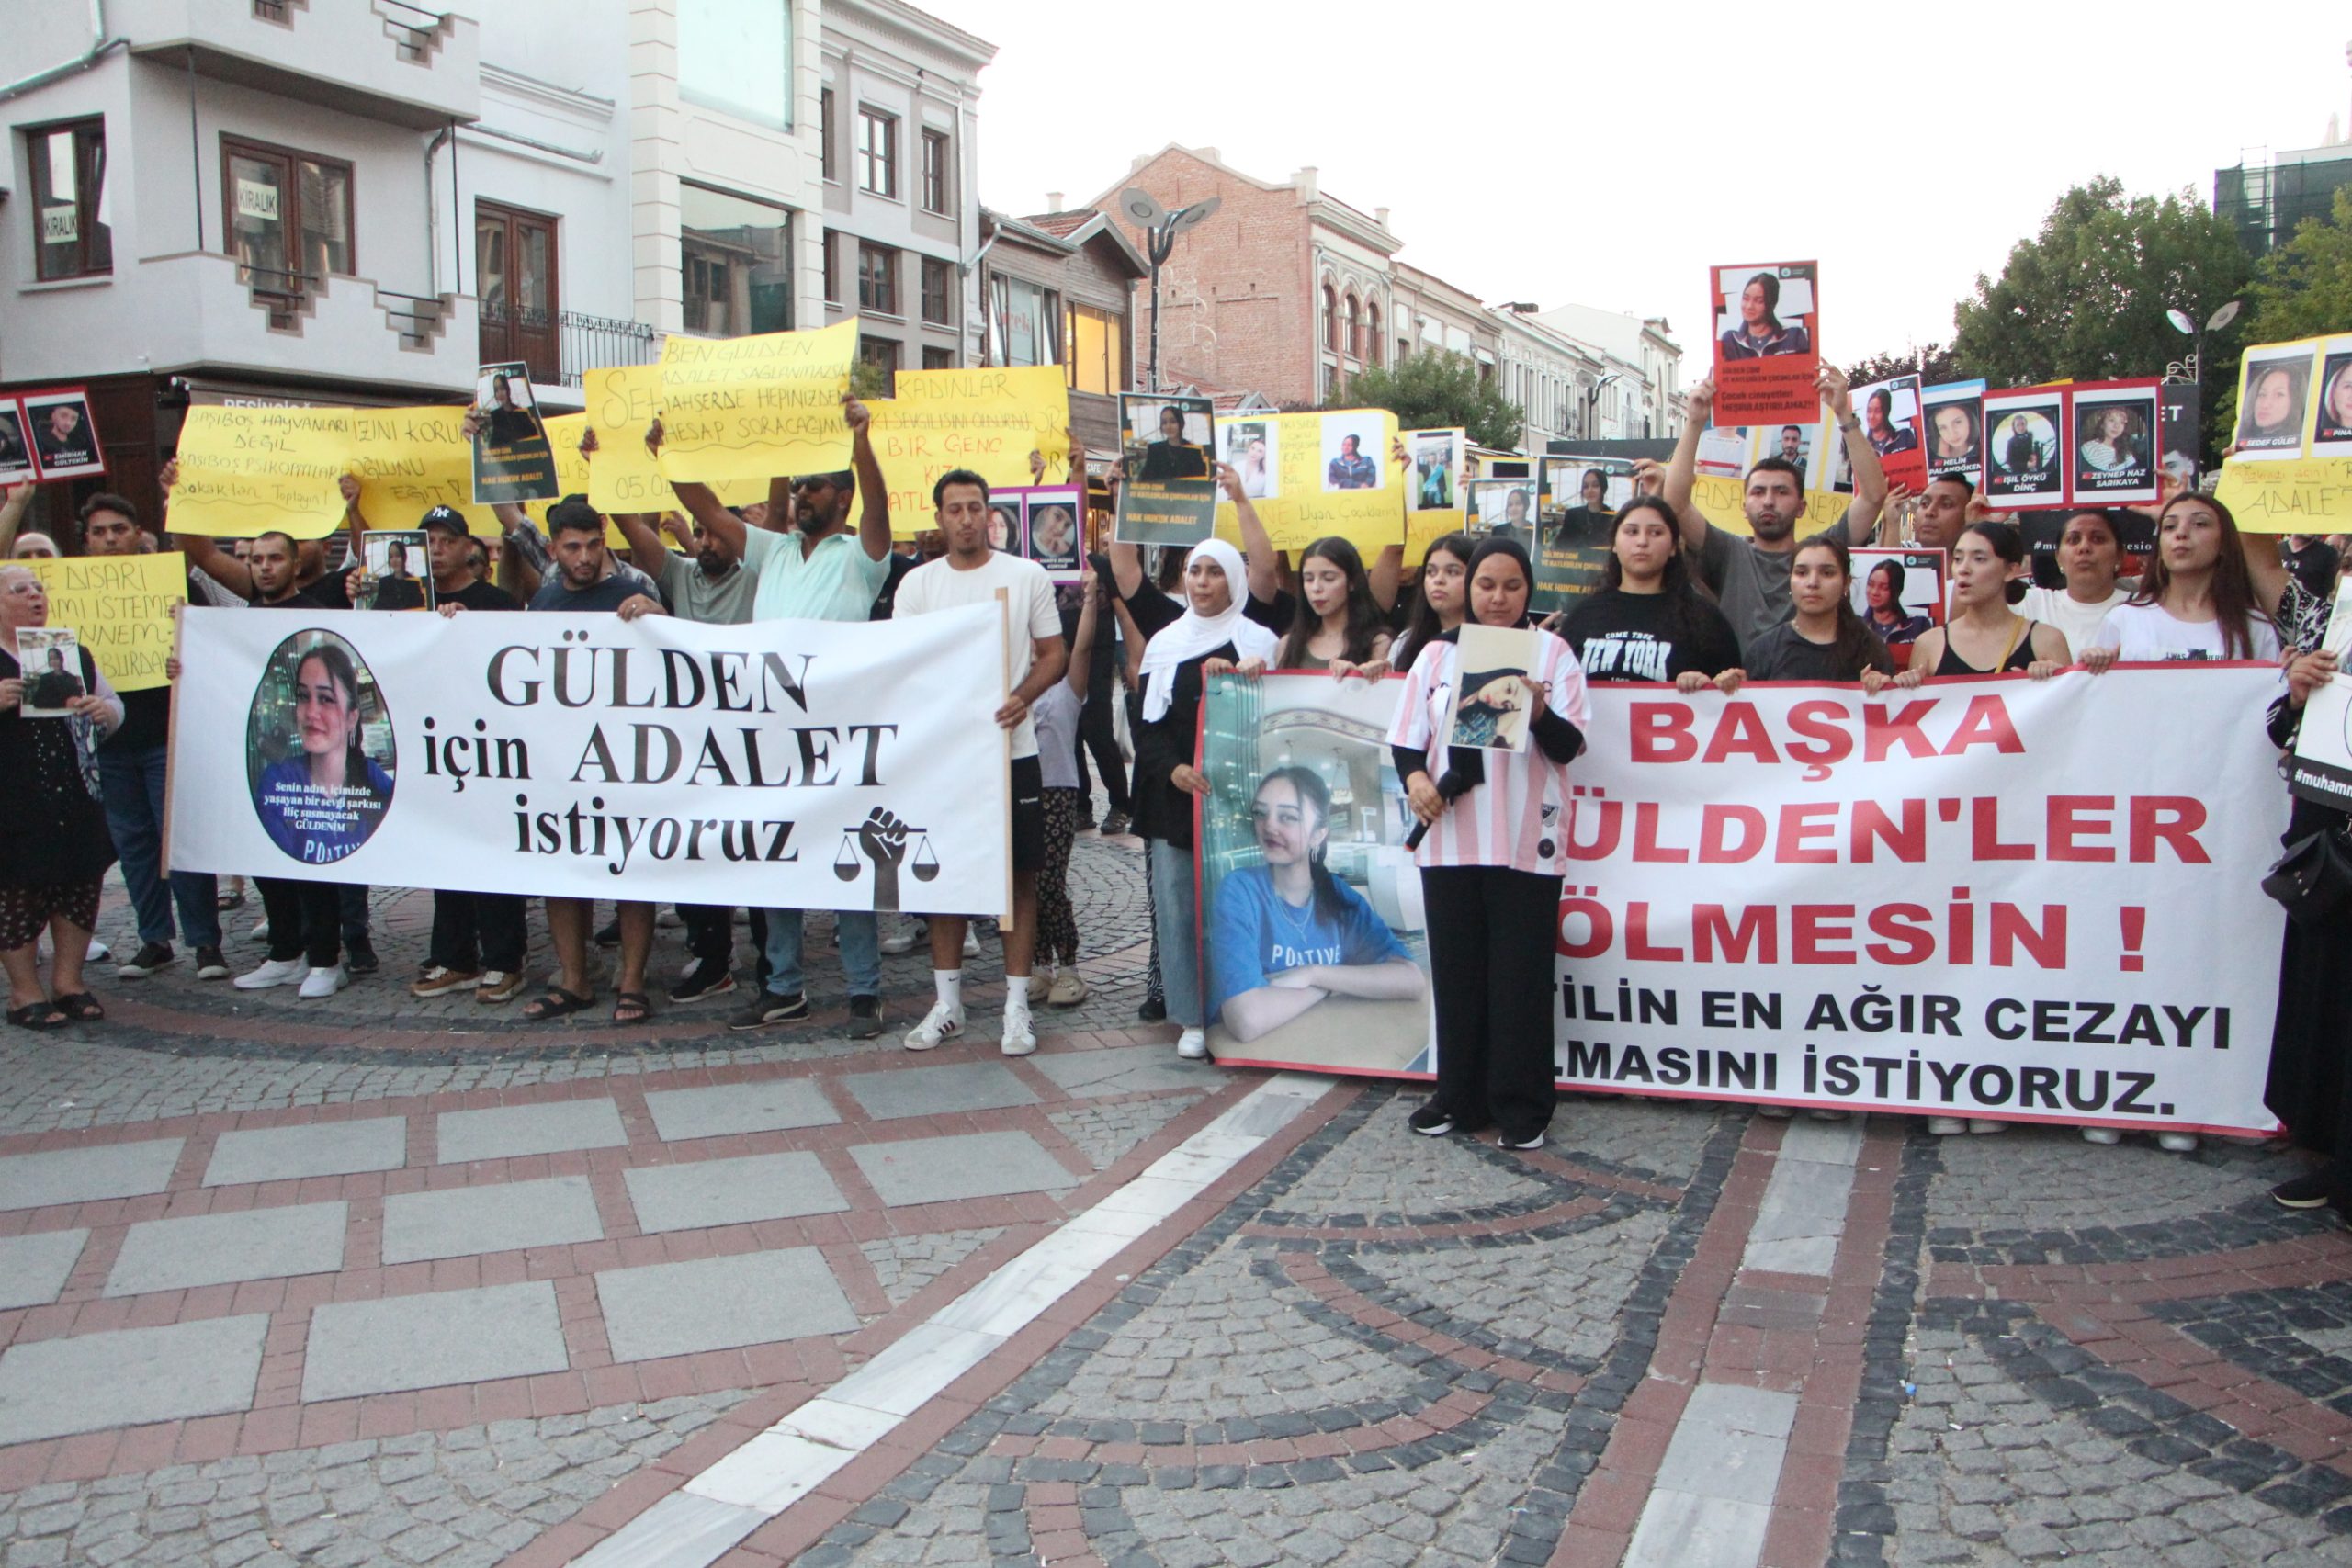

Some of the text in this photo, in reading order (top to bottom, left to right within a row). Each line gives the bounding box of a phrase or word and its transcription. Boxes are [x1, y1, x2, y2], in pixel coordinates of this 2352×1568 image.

[240, 186, 277, 215] KİRALIK
[46, 211, 78, 237] KİRALIK
[665, 341, 714, 364] BEN
[898, 372, 1017, 401] KADINLAR
[261, 413, 348, 435] HAYVANLARI
[662, 421, 725, 444] HESAP
[944, 432, 1002, 460] GENÇ
[2246, 436, 2297, 447] SEDEF GÜLER
[53, 450, 87, 460] EMİRHAN
[53, 457, 89, 467] GÜLTEKİN
[1943, 457, 1967, 467] HELİN
[521, 471, 544, 482] ADALET
[1086, 462, 1102, 474] CAFE
[1929, 464, 1982, 476] PALANDÖKEN
[2003, 472, 2047, 486] IŞIL ÖYKÜ
[2090, 468, 2146, 480] ZEYNEP NAZ
[2013, 481, 2037, 493] DİNÇ
[2095, 477, 2140, 488] SARIKAYA
[1126, 513, 1142, 522] HAK
[1170, 514, 1198, 525] ADALET
[1300, 504, 1336, 530] Uyan
[66, 562, 147, 594] DIŞARI
[1537, 581, 1554, 592] HAK
[1554, 582, 1580, 594] HUKUK
[77, 622, 169, 647] NNEM
[486, 629, 818, 715] GÜLDEN
[1623, 640, 1672, 682] YORK
[1630, 694, 2027, 783] BAŞKA
[423, 716, 899, 794] için ADALET
[275, 782, 302, 793] Senin
[330, 784, 372, 797] içimizde
[264, 795, 382, 810] yaşayan bir sevgi şarkısı
[283, 807, 360, 821] Hiç susmayacak
[295, 818, 345, 832] GÜLDENİM
[1566, 784, 2213, 865] ÜLDEN'LER
[514, 793, 799, 876] istiyoruz
[1555, 885, 2146, 973] ÖLMESİN !
[1555, 974, 2232, 1051] İLİN EN AĞIR CEZAYI
[1555, 1039, 2176, 1116] MASINI İSTİYORUZ.
